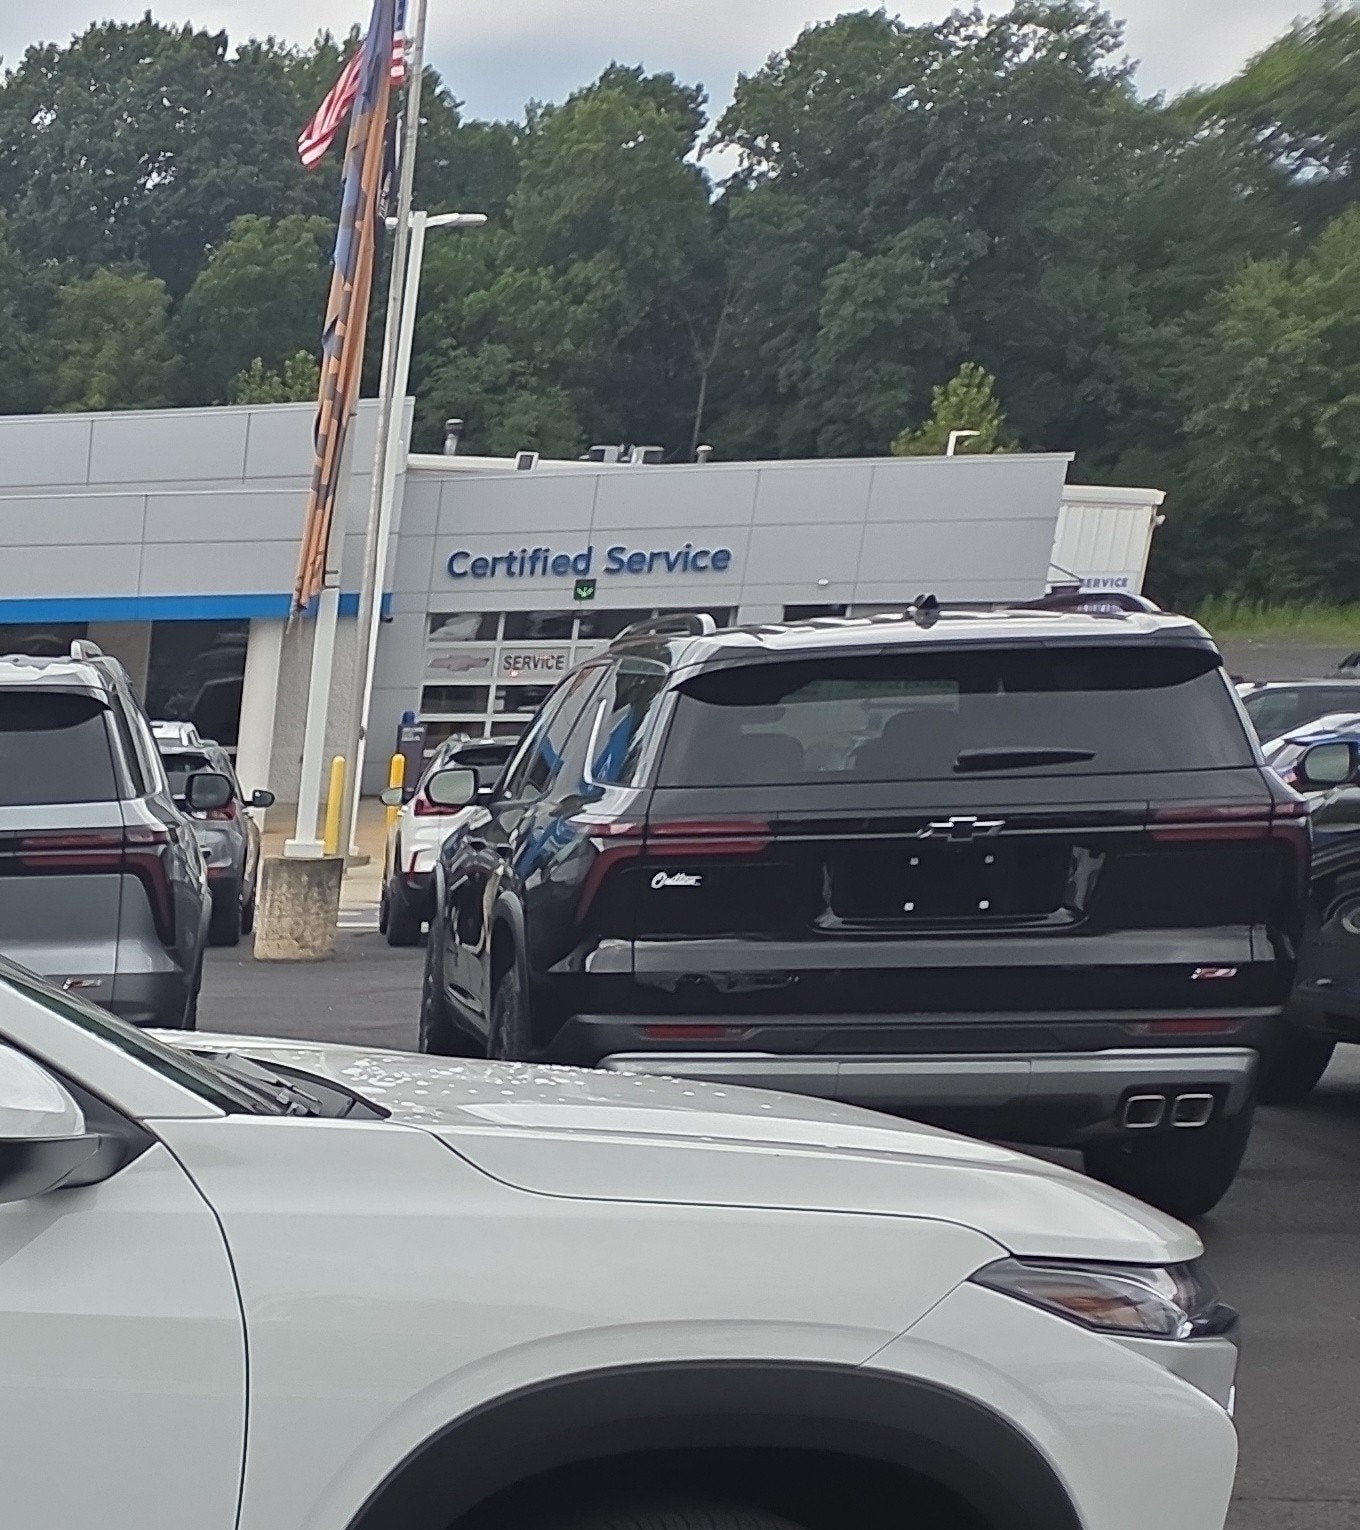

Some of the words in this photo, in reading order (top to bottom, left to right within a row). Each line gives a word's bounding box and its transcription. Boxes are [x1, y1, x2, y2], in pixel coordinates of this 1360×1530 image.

[447, 545, 593, 578] Certified
[603, 543, 732, 575] Service
[503, 654, 565, 671] SERVICE
